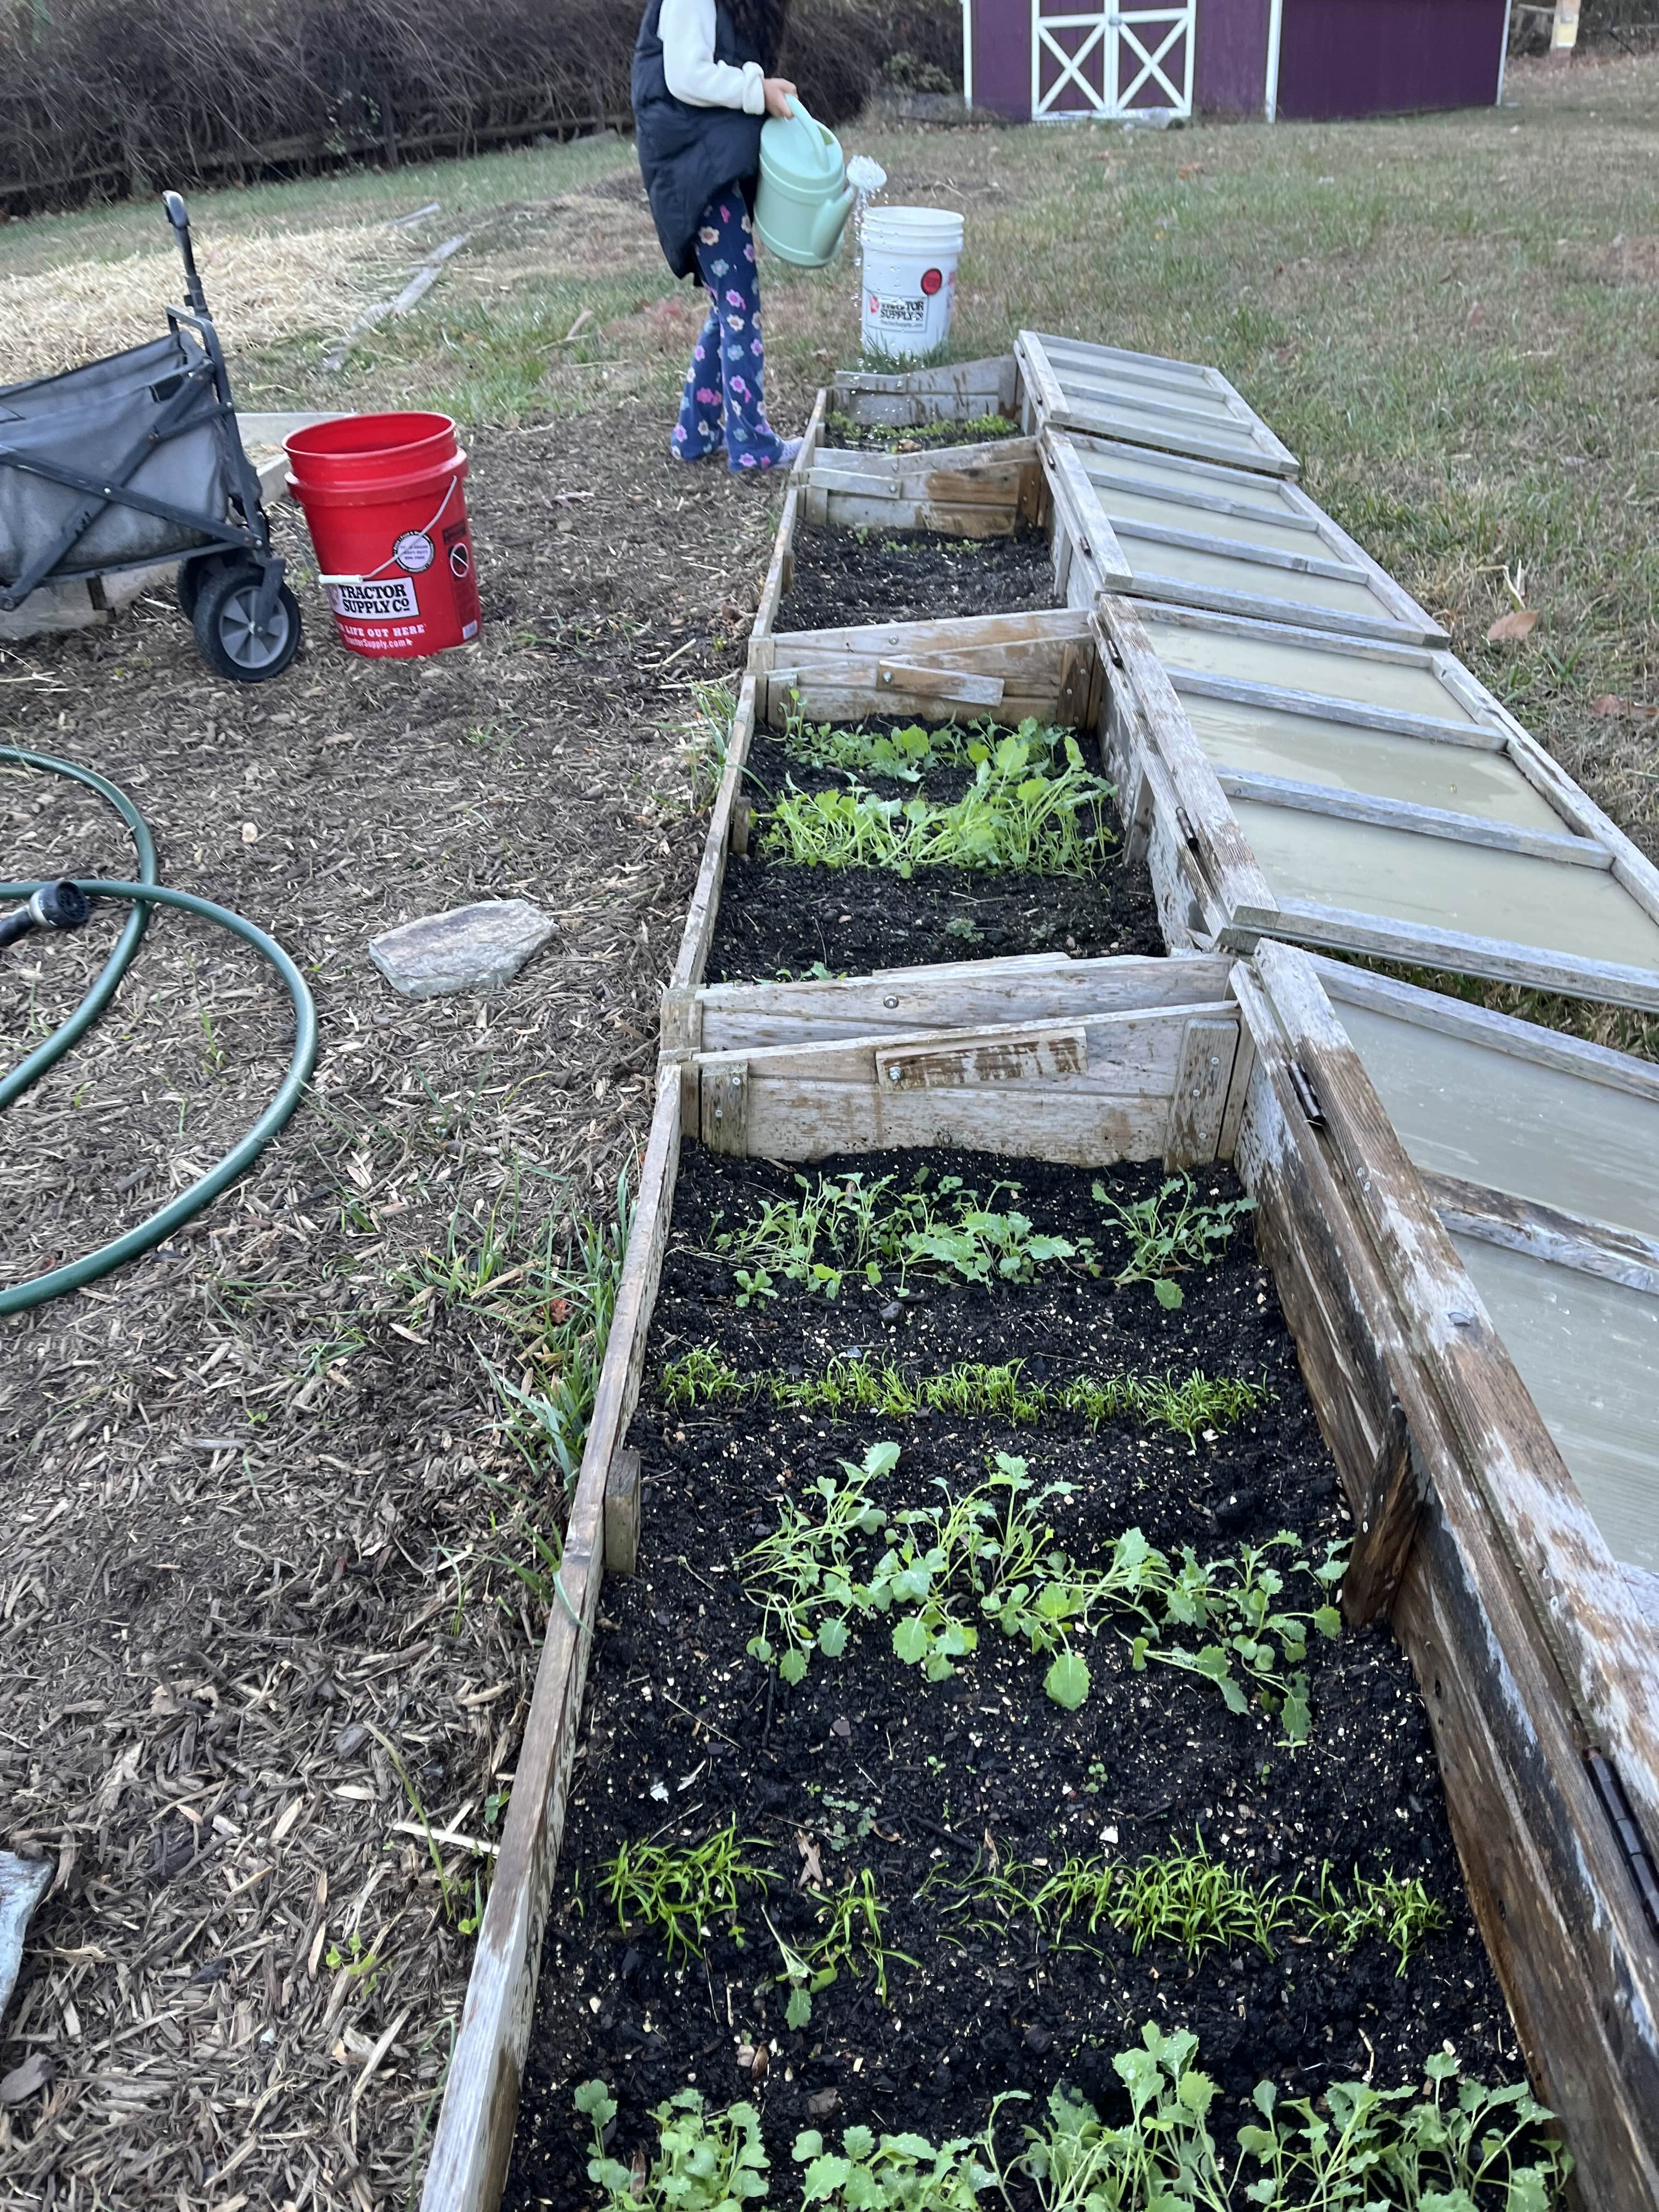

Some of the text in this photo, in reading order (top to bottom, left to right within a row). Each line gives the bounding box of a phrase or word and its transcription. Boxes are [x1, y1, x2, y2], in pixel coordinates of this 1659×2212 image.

[338, 584, 407, 599] TRACTOR
[342, 599, 391, 613] SUPPLY
[345, 625, 365, 636] LIFE
[366, 628, 389, 637] OUT
[392, 624, 425, 637] HERE
